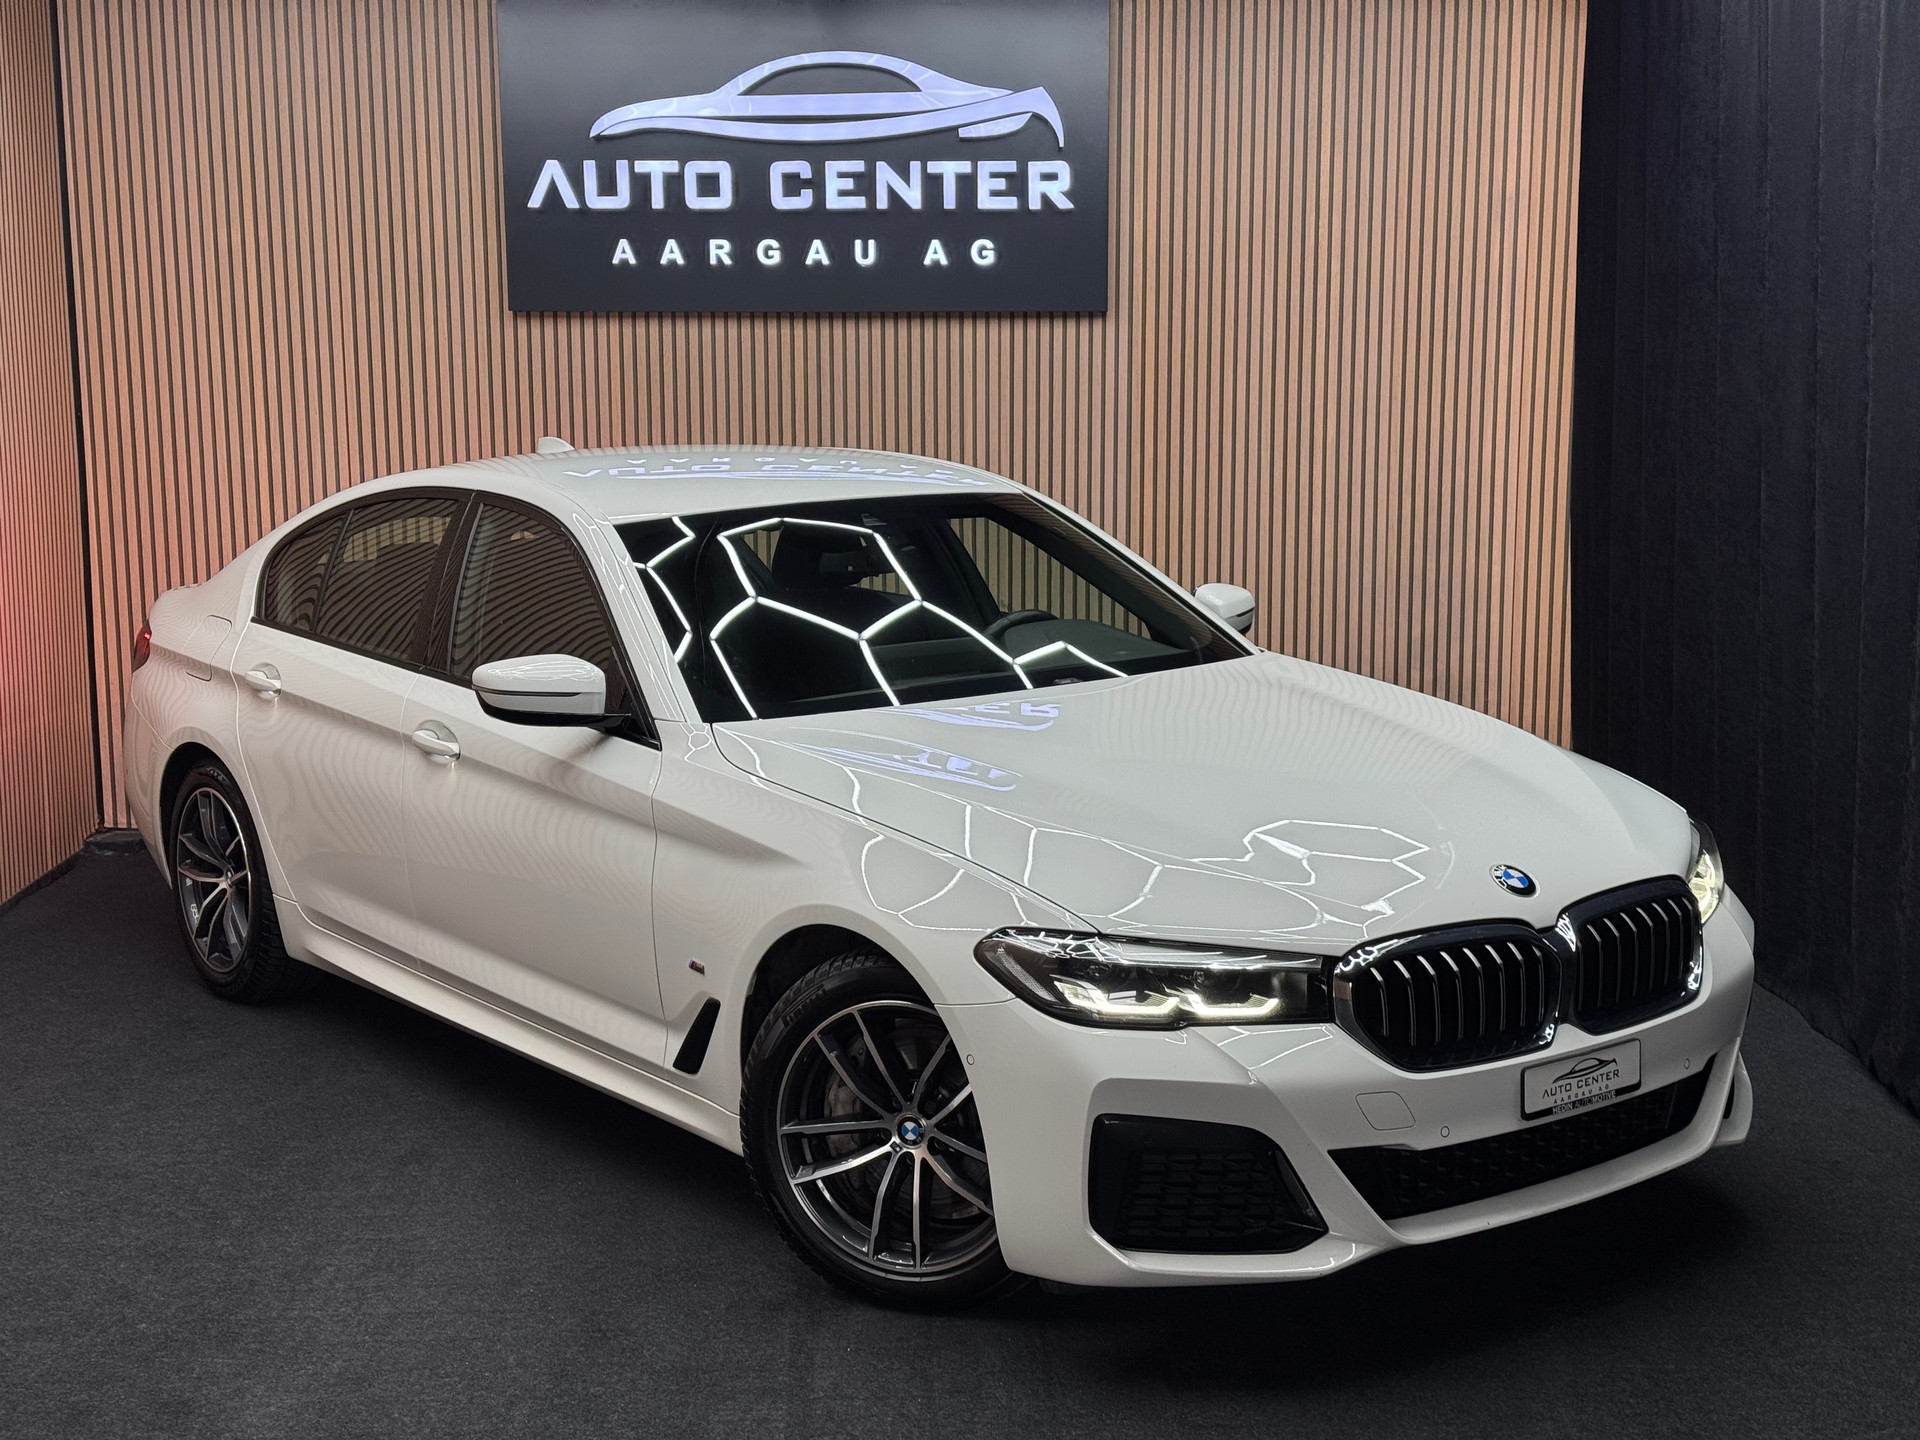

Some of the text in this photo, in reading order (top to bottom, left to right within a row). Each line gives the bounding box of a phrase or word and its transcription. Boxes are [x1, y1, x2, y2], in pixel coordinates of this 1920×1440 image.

[527, 159, 1075, 210] AUTO CENTER
[611, 238, 997, 266] AARGAU AG
[1542, 1069, 1620, 1099] AUTO CENTER
